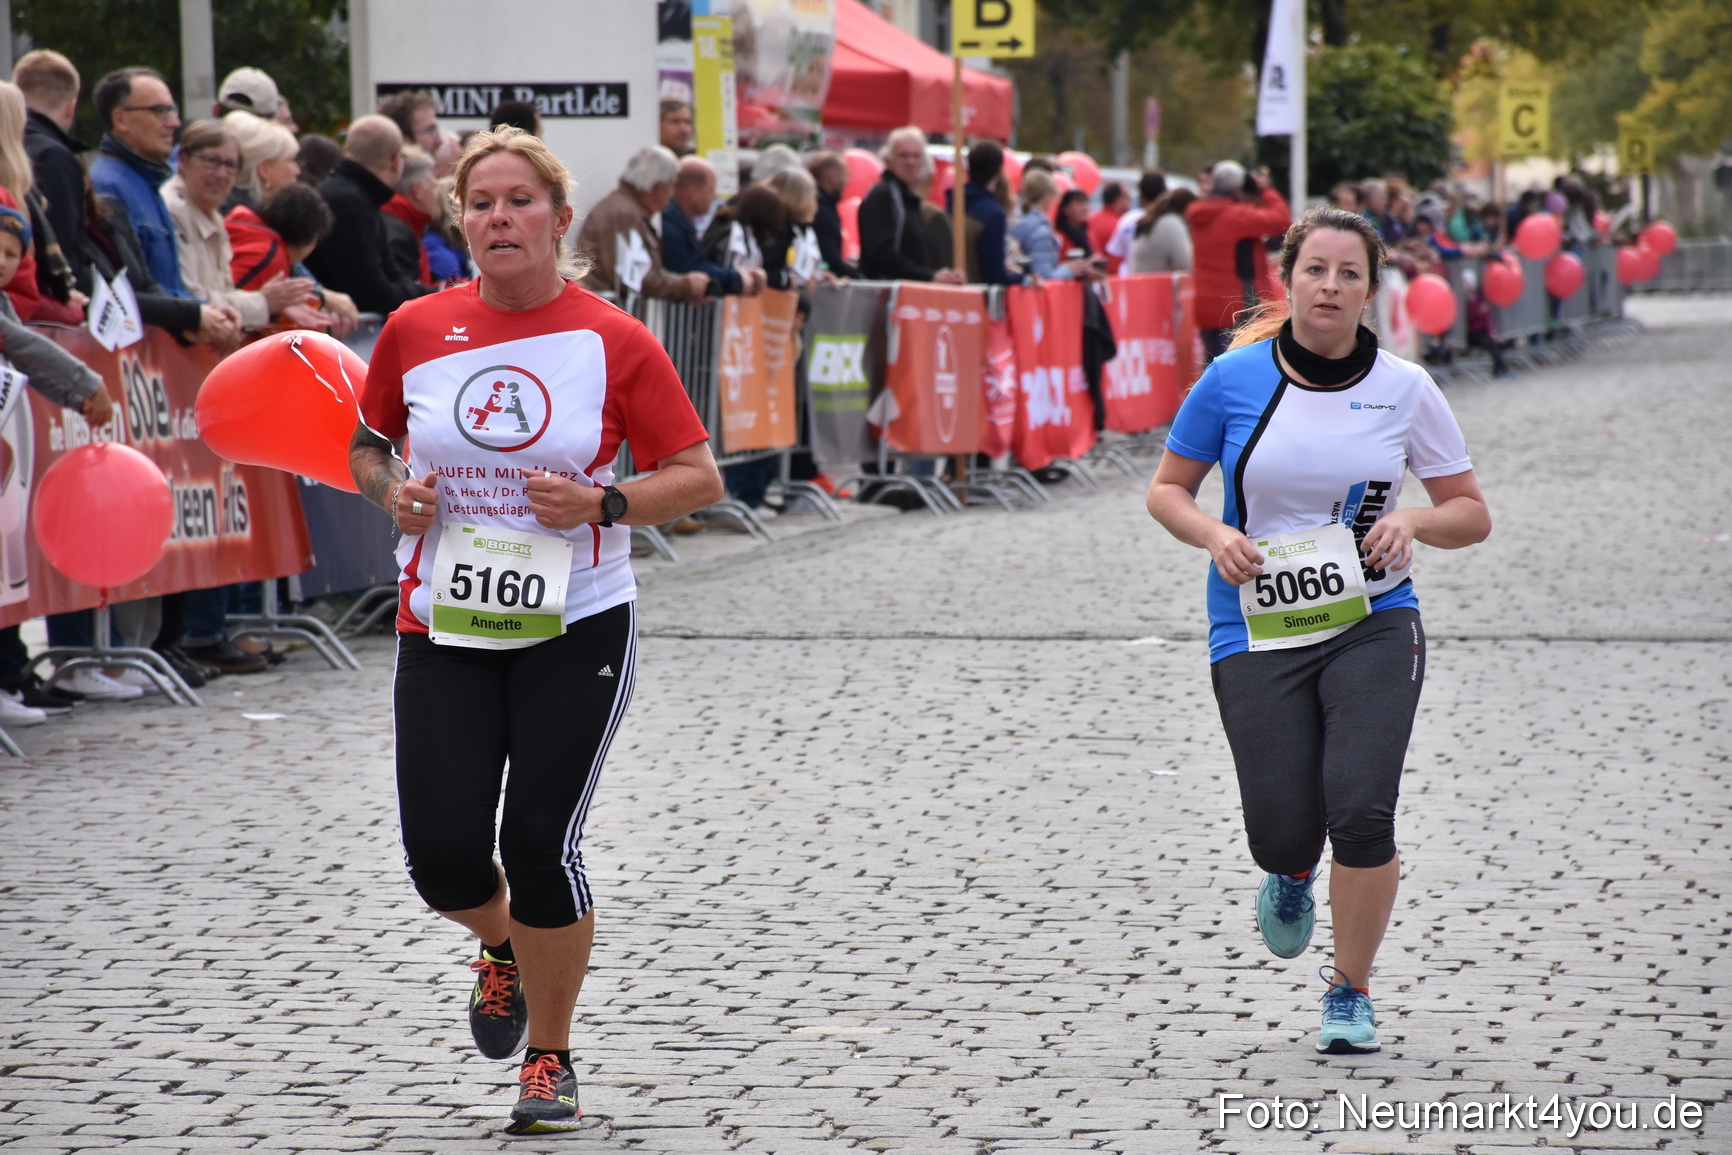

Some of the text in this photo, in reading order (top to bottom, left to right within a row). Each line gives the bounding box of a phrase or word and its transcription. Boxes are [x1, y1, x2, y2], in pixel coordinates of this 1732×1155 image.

[1512, 104, 1535, 138] C
[445, 333, 469, 342] erima
[495, 467, 523, 480] MIT
[444, 486, 458, 497] Dr.
[461, 487, 490, 498] Heck
[501, 487, 519, 497] Dr.
[486, 538, 532, 556] BOCK
[450, 563, 546, 609] 5160
[1255, 562, 1345, 608] 5066
[436, 592, 442, 600] S
[470, 616, 522, 631] Annette
[1284, 612, 1330, 628] Simone
[1411, 654, 1419, 681] Reebok
